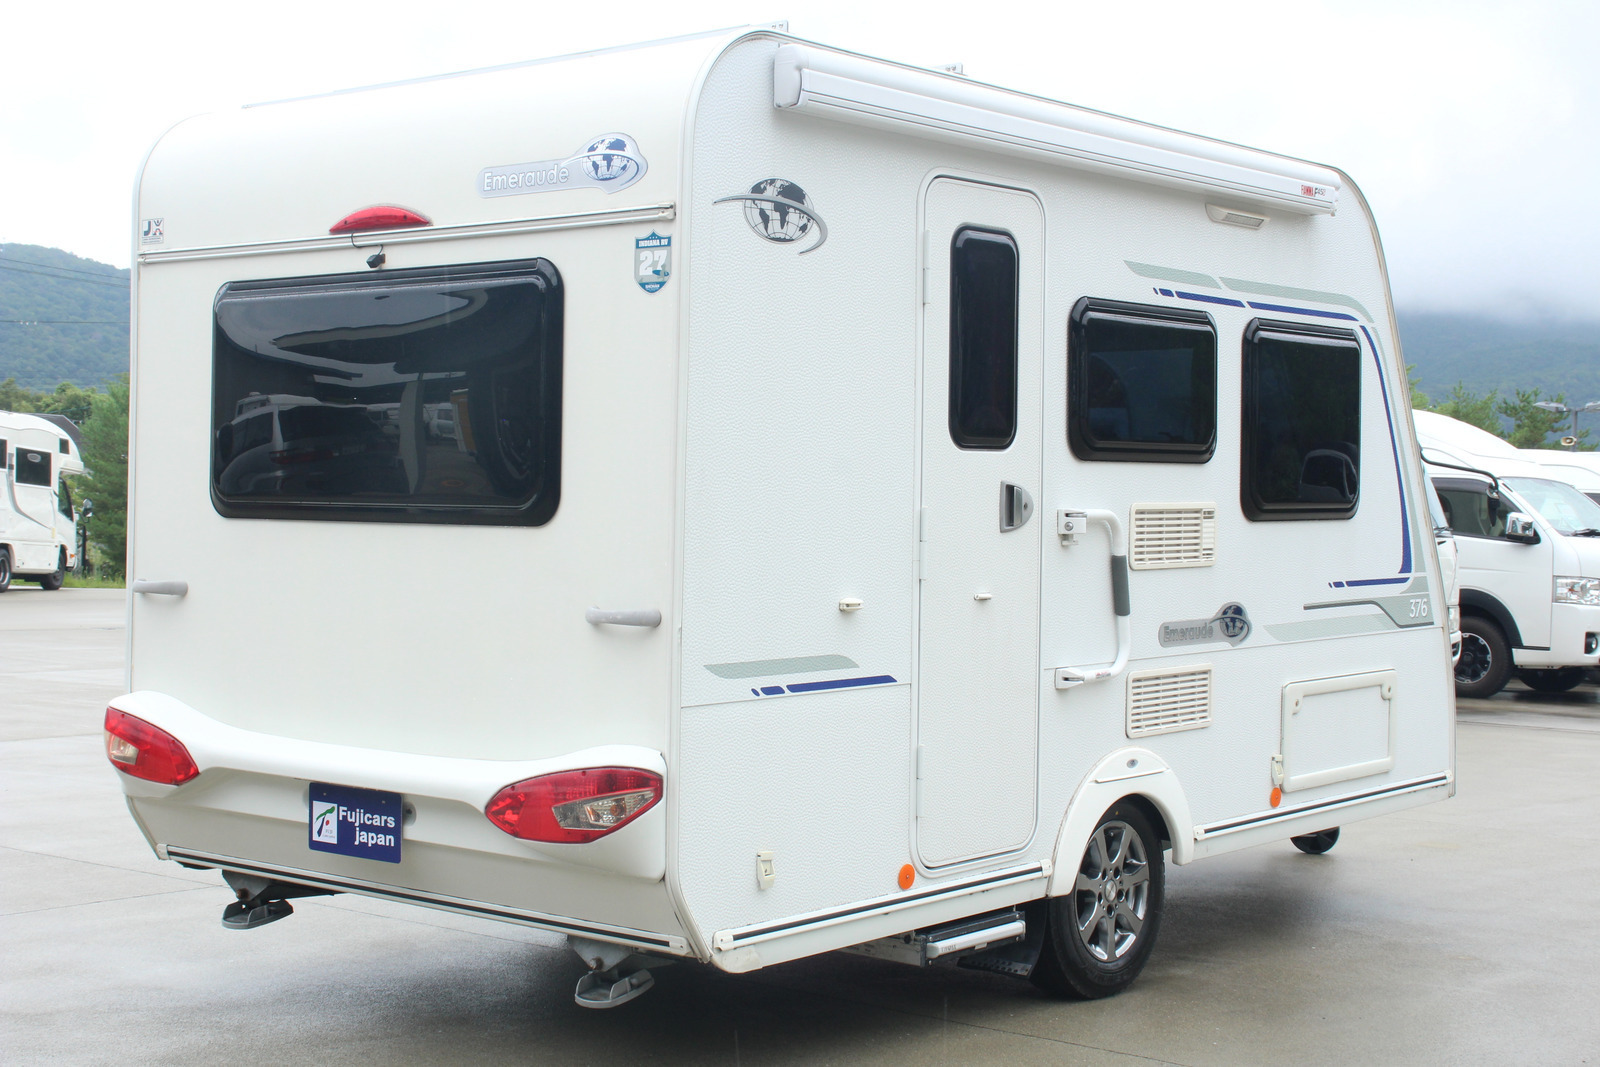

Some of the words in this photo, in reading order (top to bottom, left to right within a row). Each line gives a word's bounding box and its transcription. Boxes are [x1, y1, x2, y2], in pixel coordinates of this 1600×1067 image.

[483, 164, 569, 192] Emeraude
[660, 238, 669, 246] RV
[639, 250, 668, 276] 27
[1409, 598, 1428, 618] 376
[1163, 622, 1214, 643] Emeraude
[338, 805, 396, 829] Fujicars
[354, 827, 395, 848] japan
